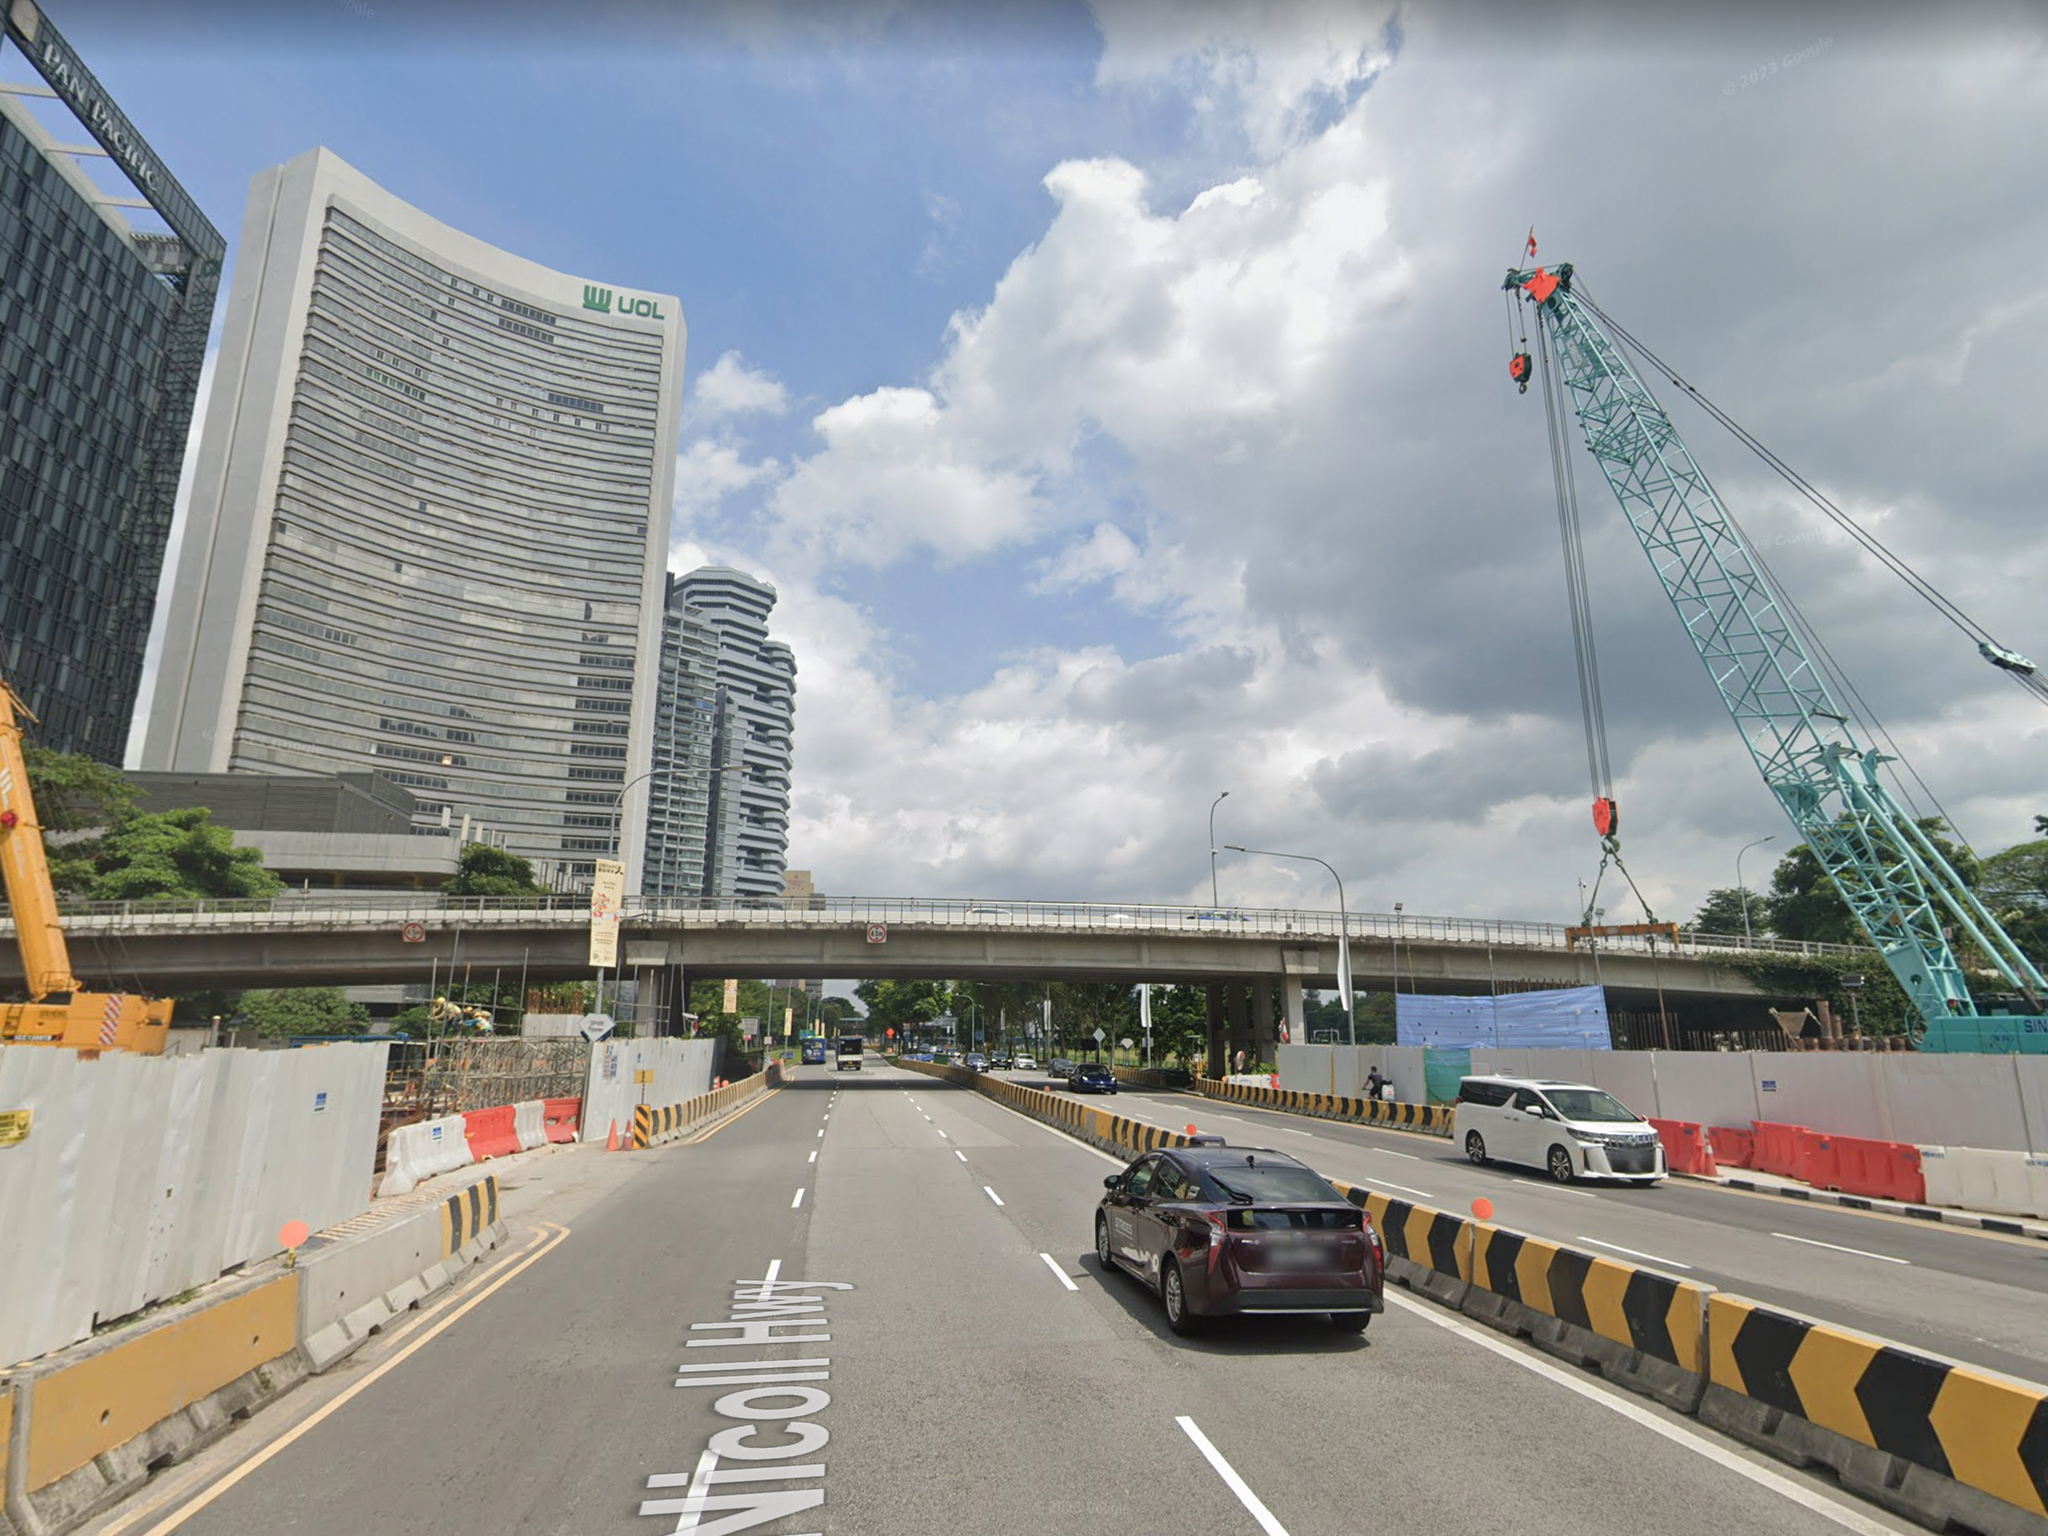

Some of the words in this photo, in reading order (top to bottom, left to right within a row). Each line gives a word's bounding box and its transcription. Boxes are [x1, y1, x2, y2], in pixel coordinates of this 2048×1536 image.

[44, 42, 85, 104] PAN
[92, 101, 159, 191] PACIFIC
[618, 296, 665, 320] UOL
